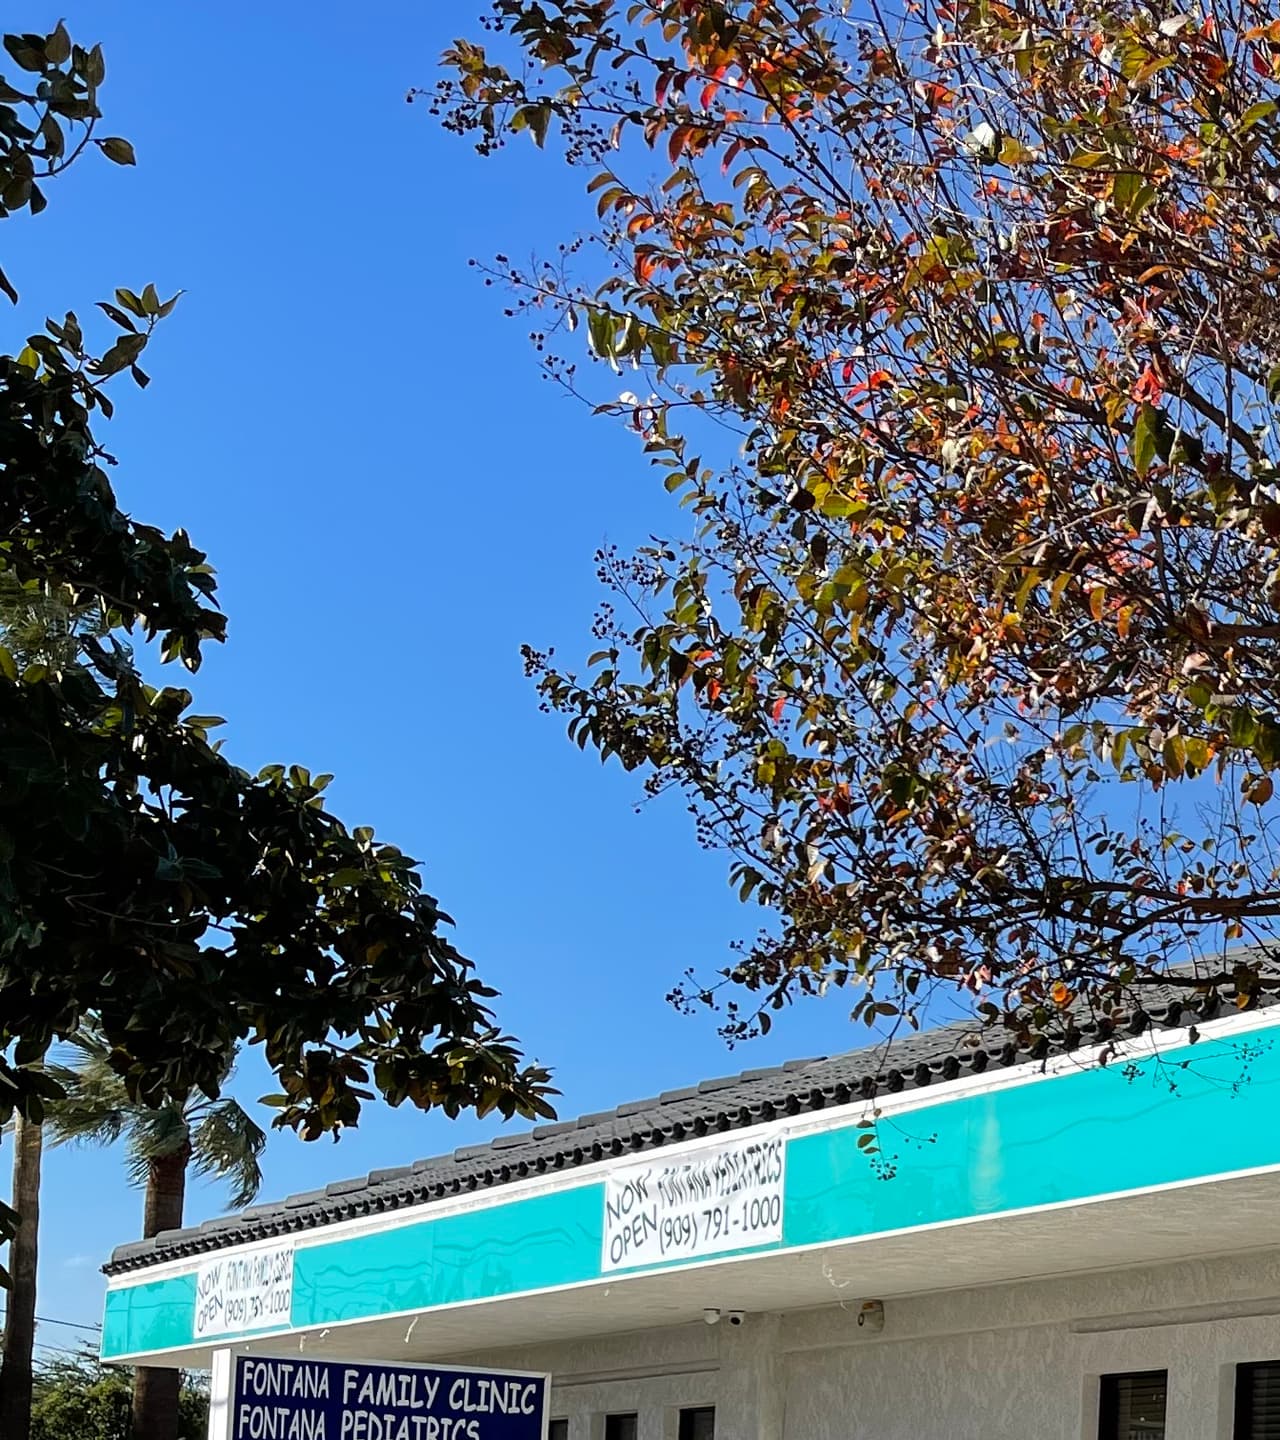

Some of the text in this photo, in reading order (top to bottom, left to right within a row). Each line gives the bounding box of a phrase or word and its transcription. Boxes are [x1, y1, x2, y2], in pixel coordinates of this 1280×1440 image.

[606, 1168, 652, 1229] NOW
[659, 1194, 781, 1256] (909) 791-1000
[610, 1203, 657, 1264] OPEN
[198, 1262, 223, 1300] NOW
[197, 1289, 223, 1332] OPEN
[242, 1360, 537, 1414] FONTANA FAMILY CLINIC
